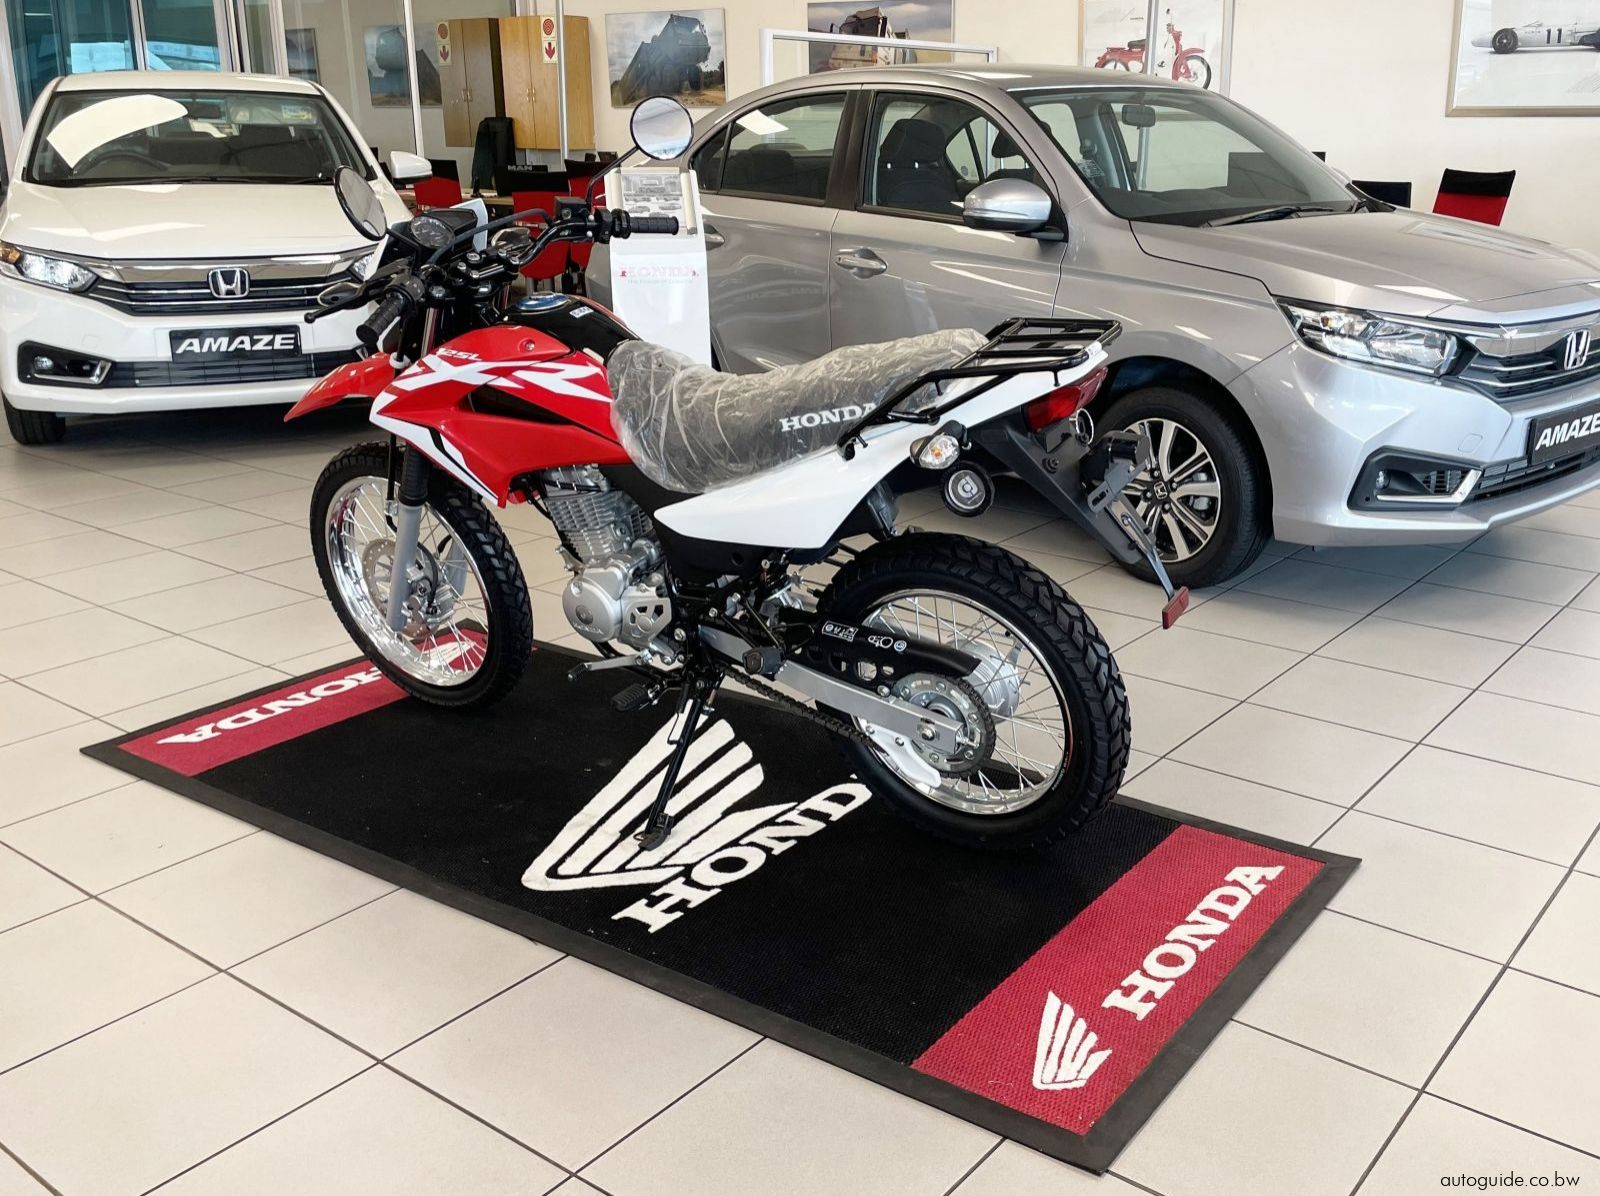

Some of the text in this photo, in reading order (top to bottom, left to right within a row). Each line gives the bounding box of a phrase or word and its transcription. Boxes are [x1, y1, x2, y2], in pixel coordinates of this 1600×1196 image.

[1546, 28, 1562, 44] 11
[176, 334, 295, 354] AMAZE
[779, 402, 877, 432] HONDA
[1535, 412, 1600, 451] AMAZE
[611, 774, 873, 934] HOND
[1101, 865, 1285, 1021] HONDA
